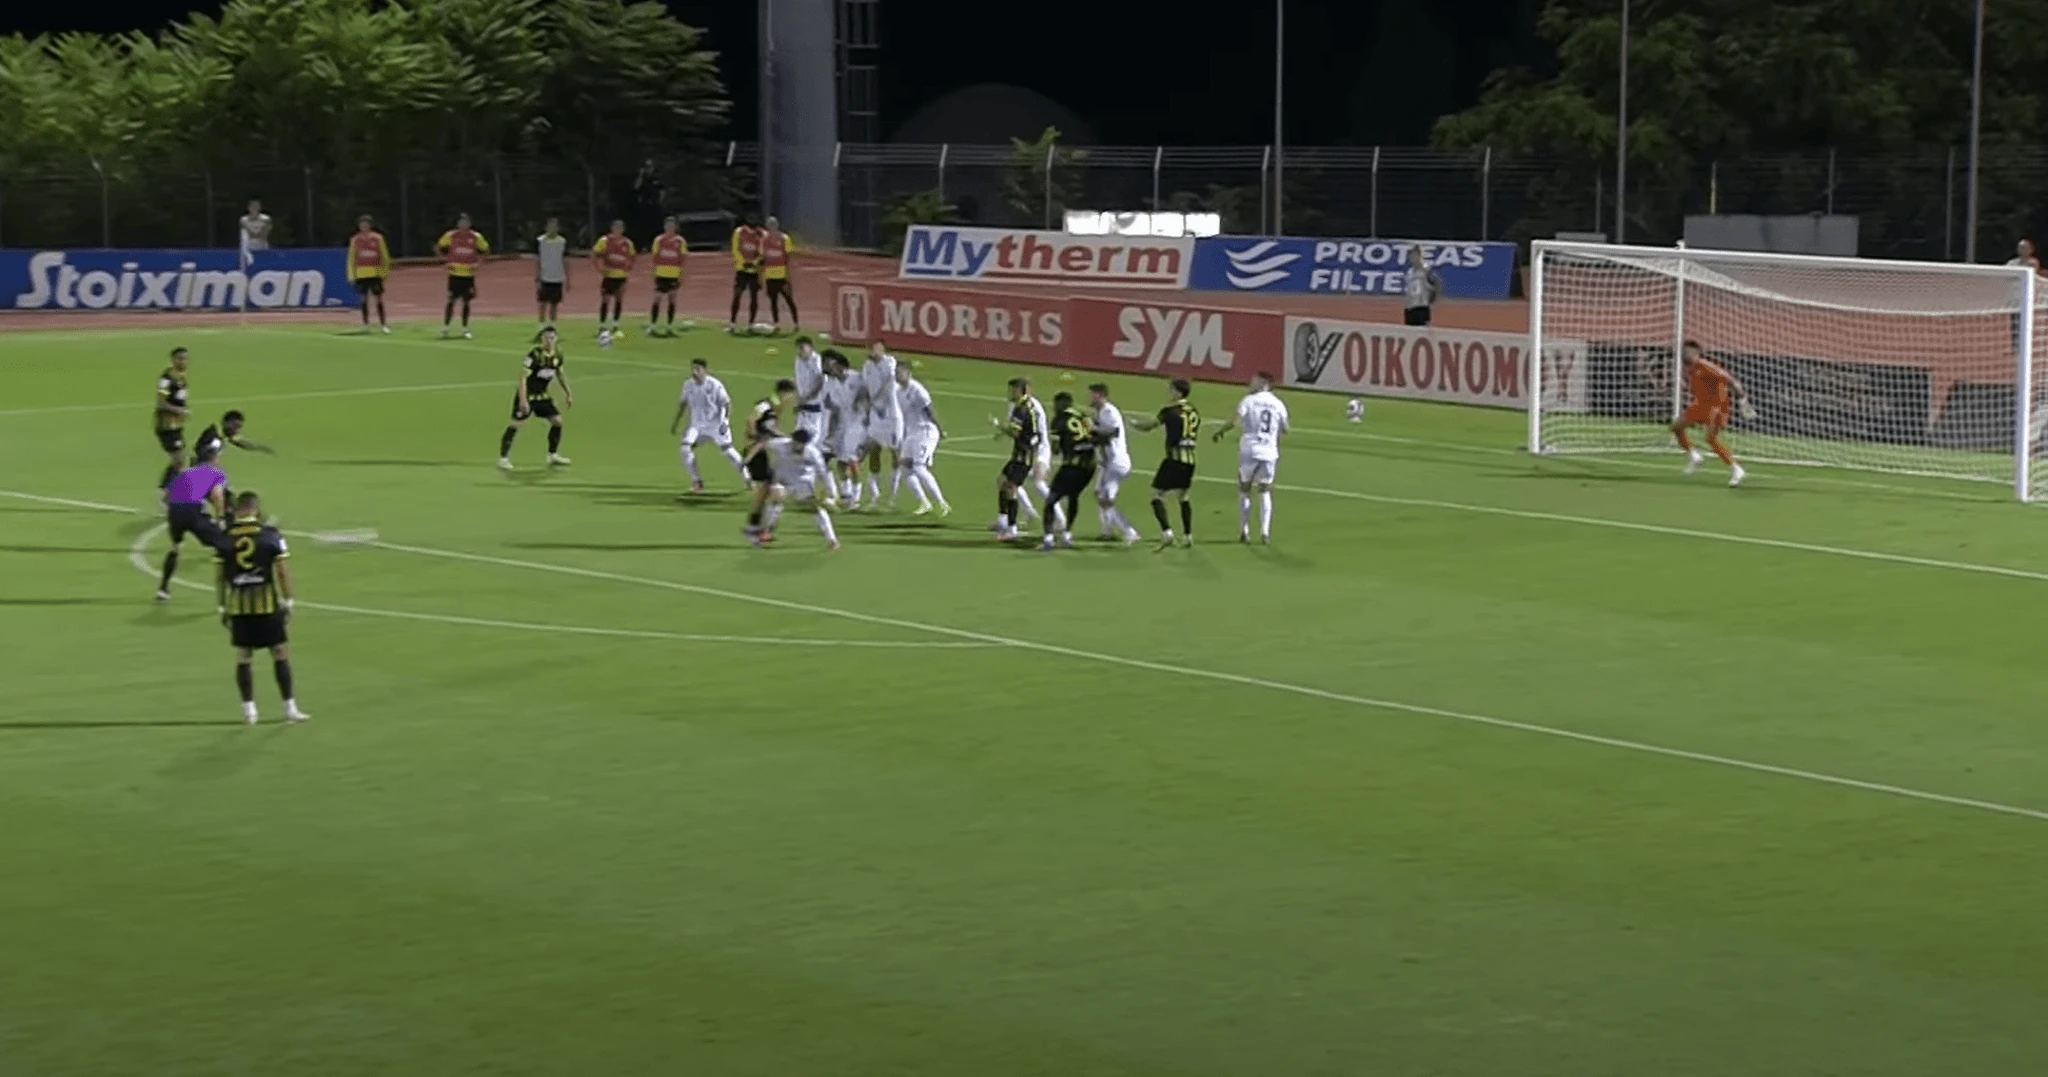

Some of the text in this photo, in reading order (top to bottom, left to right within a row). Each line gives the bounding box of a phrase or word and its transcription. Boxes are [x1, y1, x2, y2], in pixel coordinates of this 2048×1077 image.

[906, 230, 1181, 275] Mytherm
[1314, 241, 1484, 267] PROTEAS
[16, 252, 324, 308] Stoiximan
[1309, 269, 1408, 292] FILTE
[881, 299, 1063, 346] MORRIS
[1112, 307, 1234, 370] SYM
[1260, 409, 1272, 433] 9
[234, 536, 256, 569] 2
